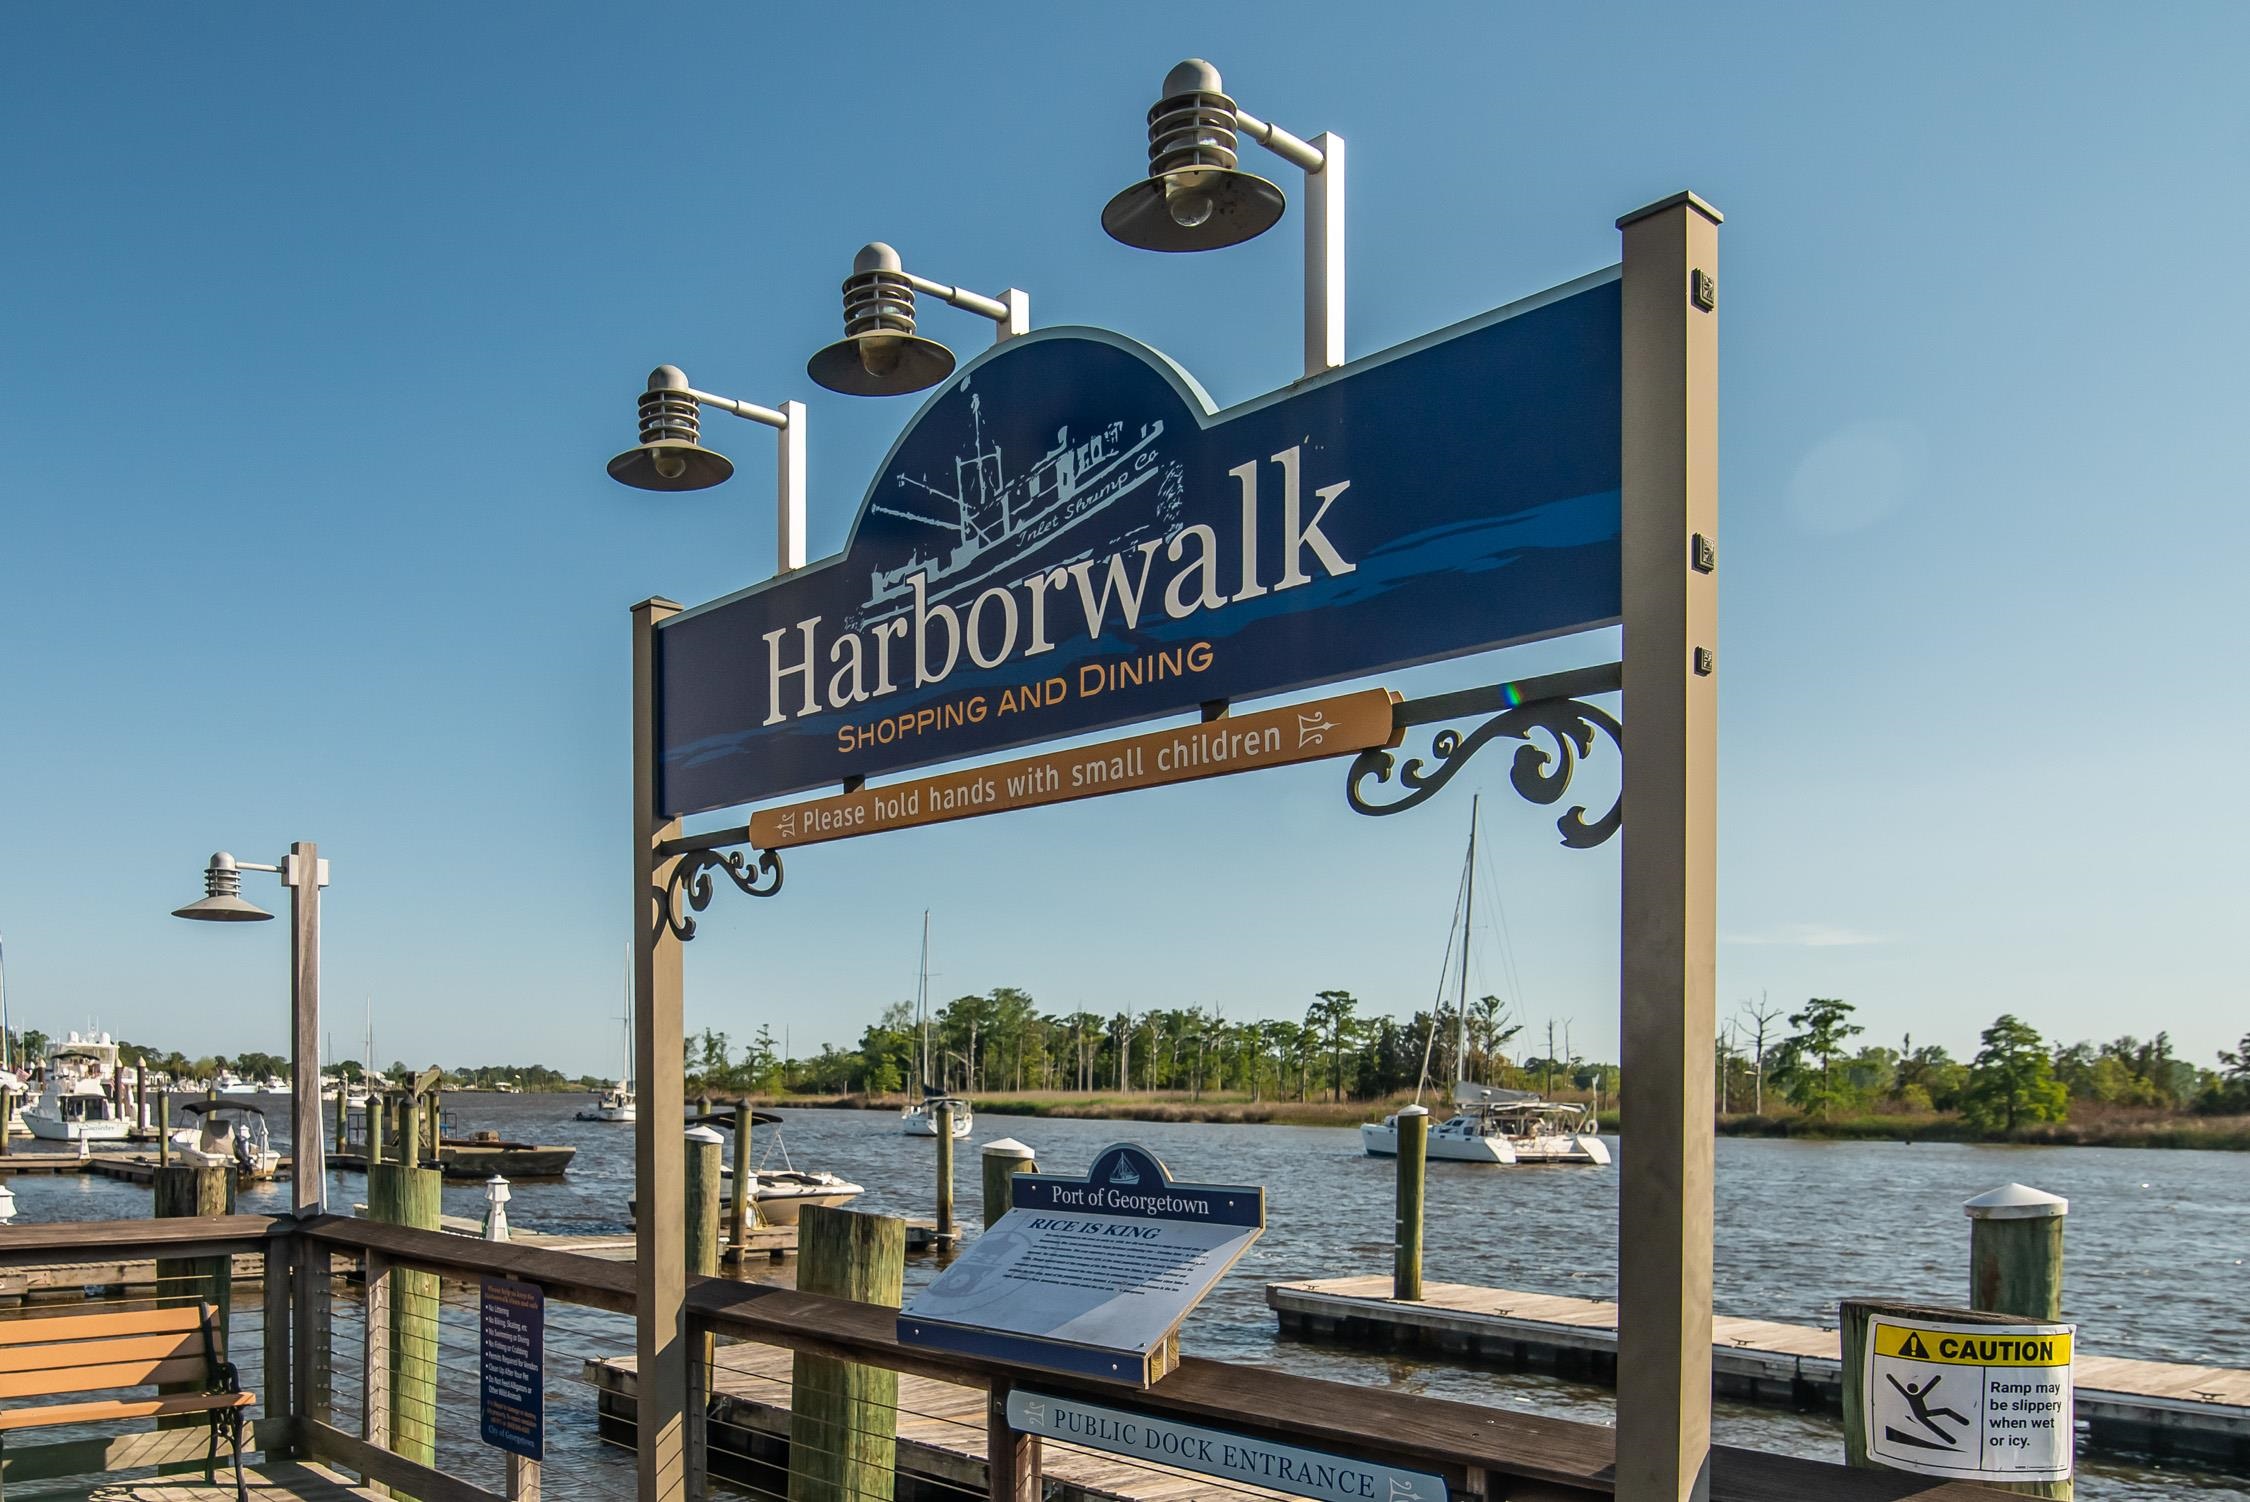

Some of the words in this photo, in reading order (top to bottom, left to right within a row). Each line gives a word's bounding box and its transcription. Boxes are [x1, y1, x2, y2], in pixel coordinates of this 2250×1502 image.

[1016, 515, 1059, 547] Inlet
[1134, 450, 1159, 471] Co
[762, 445, 1357, 727] Harborwalk
[838, 696, 988, 753] SHOPPING
[997, 677, 1067, 717] AND
[1079, 641, 1214, 698] DINING
[804, 805, 865, 833] Please
[875, 790, 919, 821] hold
[930, 777, 996, 812] hands
[1007, 764, 1059, 798] with
[1072, 747, 1144, 787] small
[1157, 727, 1281, 771] children
[1052, 1185, 1084, 1205] Port
[1088, 1187, 1106, 1207] of
[1109, 1190, 1210, 1215] Georgetown
[1027, 1218, 1080, 1233] RICE
[1077, 1222, 1104, 1234] IS
[1102, 1224, 1162, 1240] KING
[1939, 1338, 2053, 1362] CAUTION
[1990, 1381, 2032, 1396] Ramp
[2035, 1383, 2061, 1394] may
[1990, 1399, 2008, 1411] be
[2011, 1399, 2062, 1414] slippery
[1989, 1417, 2028, 1429] when
[2031, 1417, 2055, 1429] wet
[1054, 1408, 1137, 1446] PUBLIC
[1145, 1428, 1214, 1464] DOCK
[1222, 1445, 1376, 1499] ENTRANCE
[1989, 1437, 2005, 1447] or
[2008, 1435, 2031, 1450] icy.
